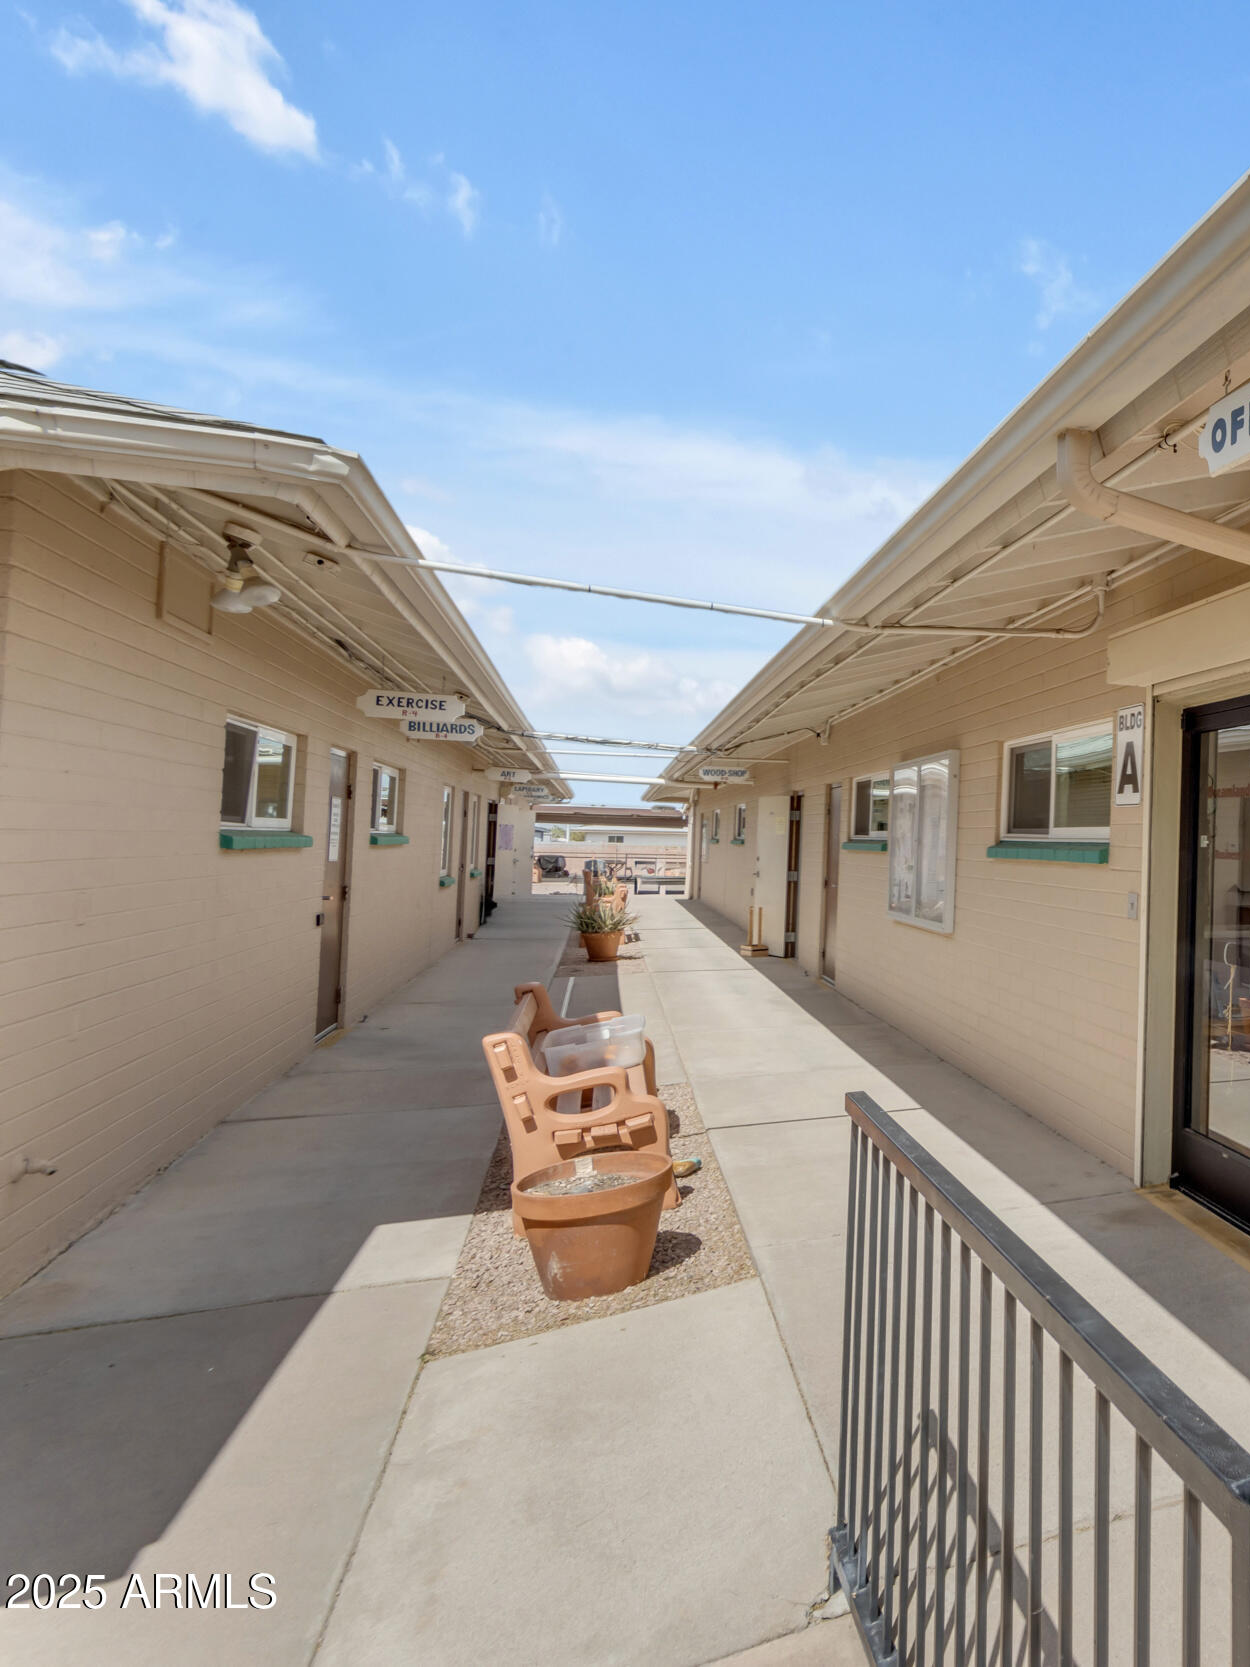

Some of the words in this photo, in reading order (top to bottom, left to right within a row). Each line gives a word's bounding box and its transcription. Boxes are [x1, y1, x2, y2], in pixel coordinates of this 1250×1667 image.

[375, 695, 447, 711] EXERCISE
[407, 720, 476, 735] BILLIARDS
[1119, 711, 1142, 732] BLDG
[703, 769, 727, 777] WOOD
[1117, 741, 1140, 794] A
